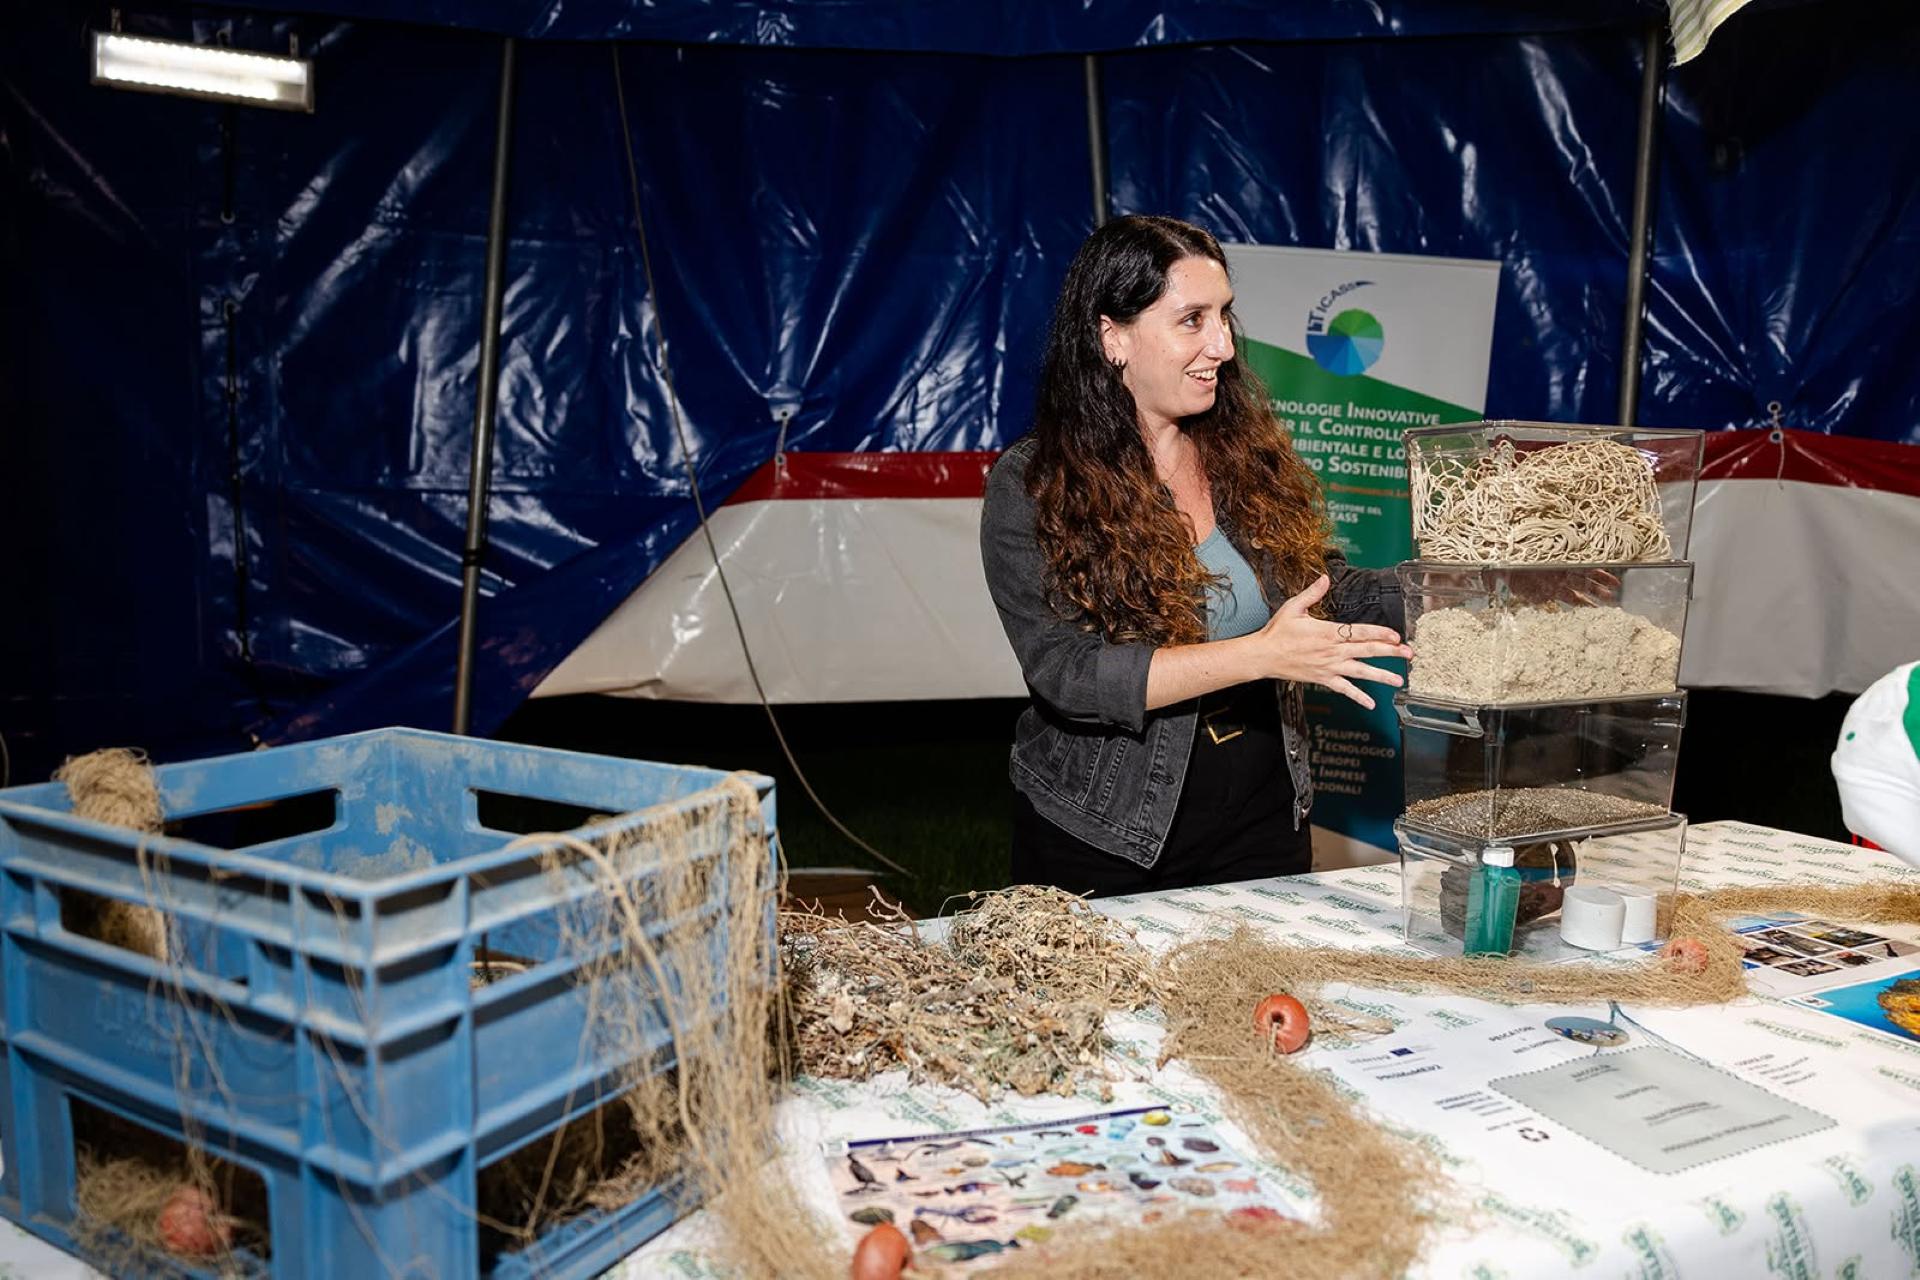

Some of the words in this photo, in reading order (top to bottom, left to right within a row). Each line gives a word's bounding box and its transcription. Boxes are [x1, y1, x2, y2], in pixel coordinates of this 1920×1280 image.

[1274, 401, 1342, 417] NOLOGIE
[1347, 402, 1440, 425] INNOVATIVE
[1301, 422, 1313, 434] IL
[1318, 418, 1402, 441] CONTROLL
[1372, 445, 1383, 458] E
[1386, 447, 1406, 461] LO
[1317, 739, 1396, 758] TECNOLOGICO
